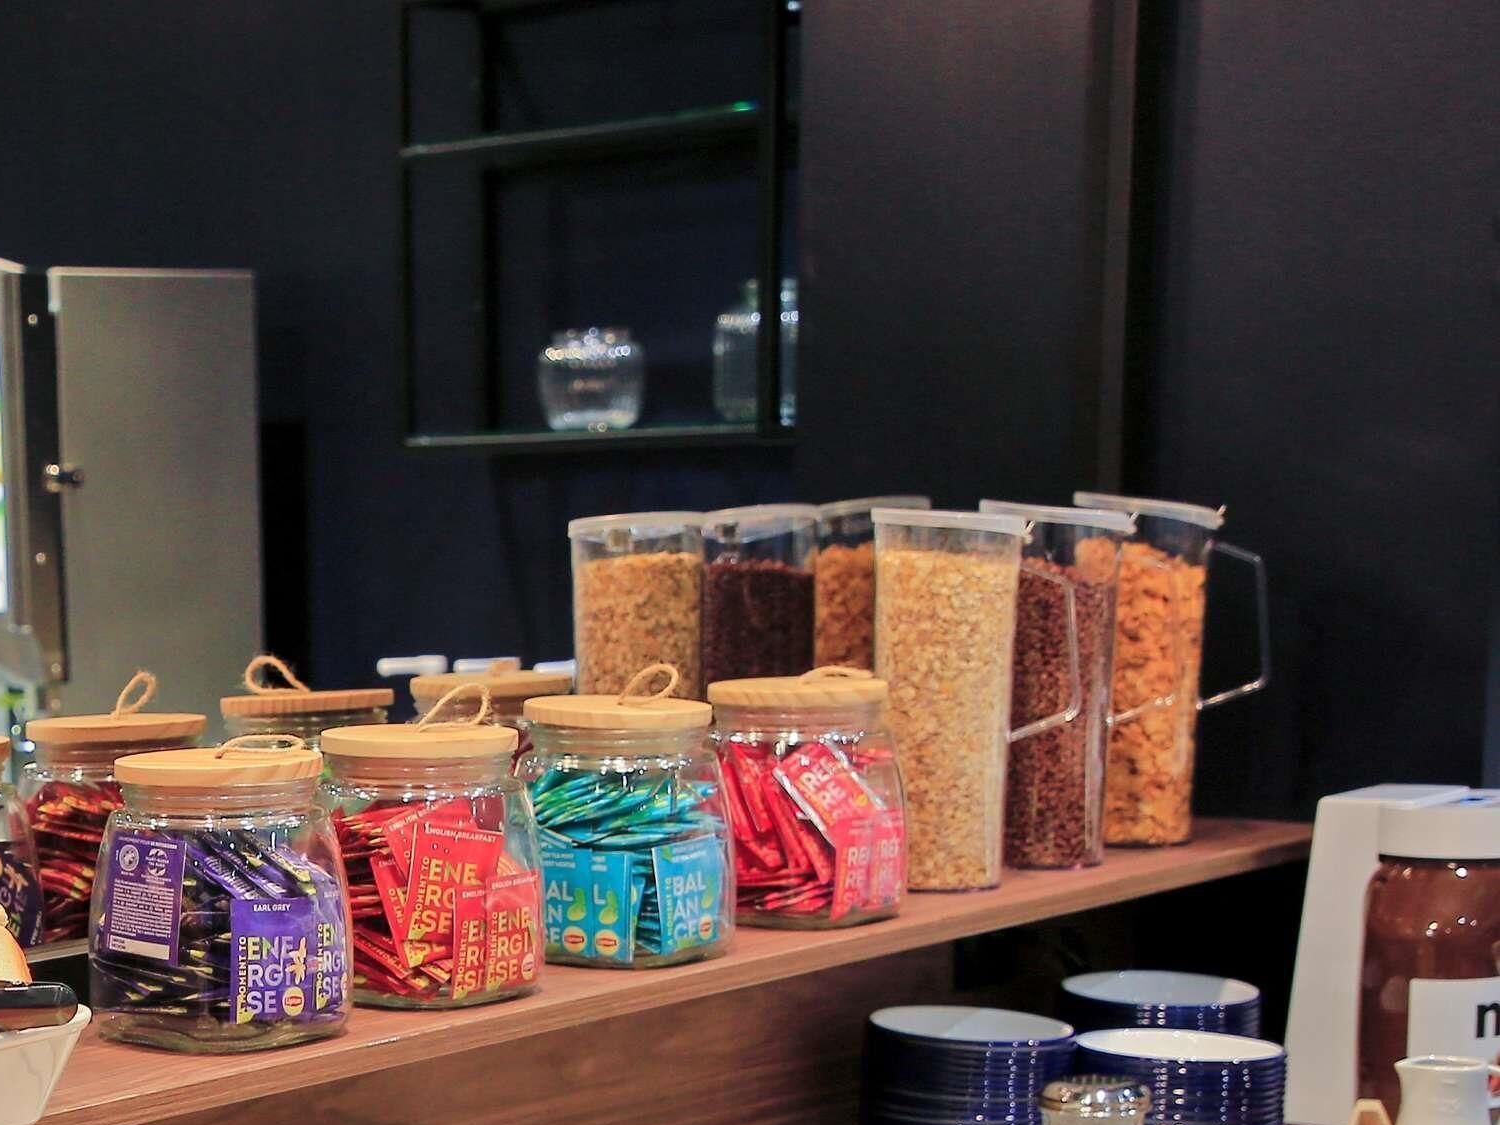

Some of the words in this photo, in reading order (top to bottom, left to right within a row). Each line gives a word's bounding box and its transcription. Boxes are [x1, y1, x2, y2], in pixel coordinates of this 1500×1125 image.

[425, 826, 456, 838] ENGLISH
[457, 830, 497, 843] BREAKFAST
[428, 858, 478, 885] ENE
[546, 880, 574, 902] AL
[672, 871, 707, 898] BAL
[253, 903, 271, 912] EARL
[272, 903, 291, 912] GREY
[498, 906, 531, 932] ENE
[674, 897, 700, 921] AN
[421, 909, 453, 935] SE
[674, 919, 699, 941] CE
[238, 936, 247, 953] TO
[247, 936, 294, 960] ENE
[498, 931, 529, 959] RGI
[496, 958, 519, 982] SE
[246, 990, 278, 1015] SE
